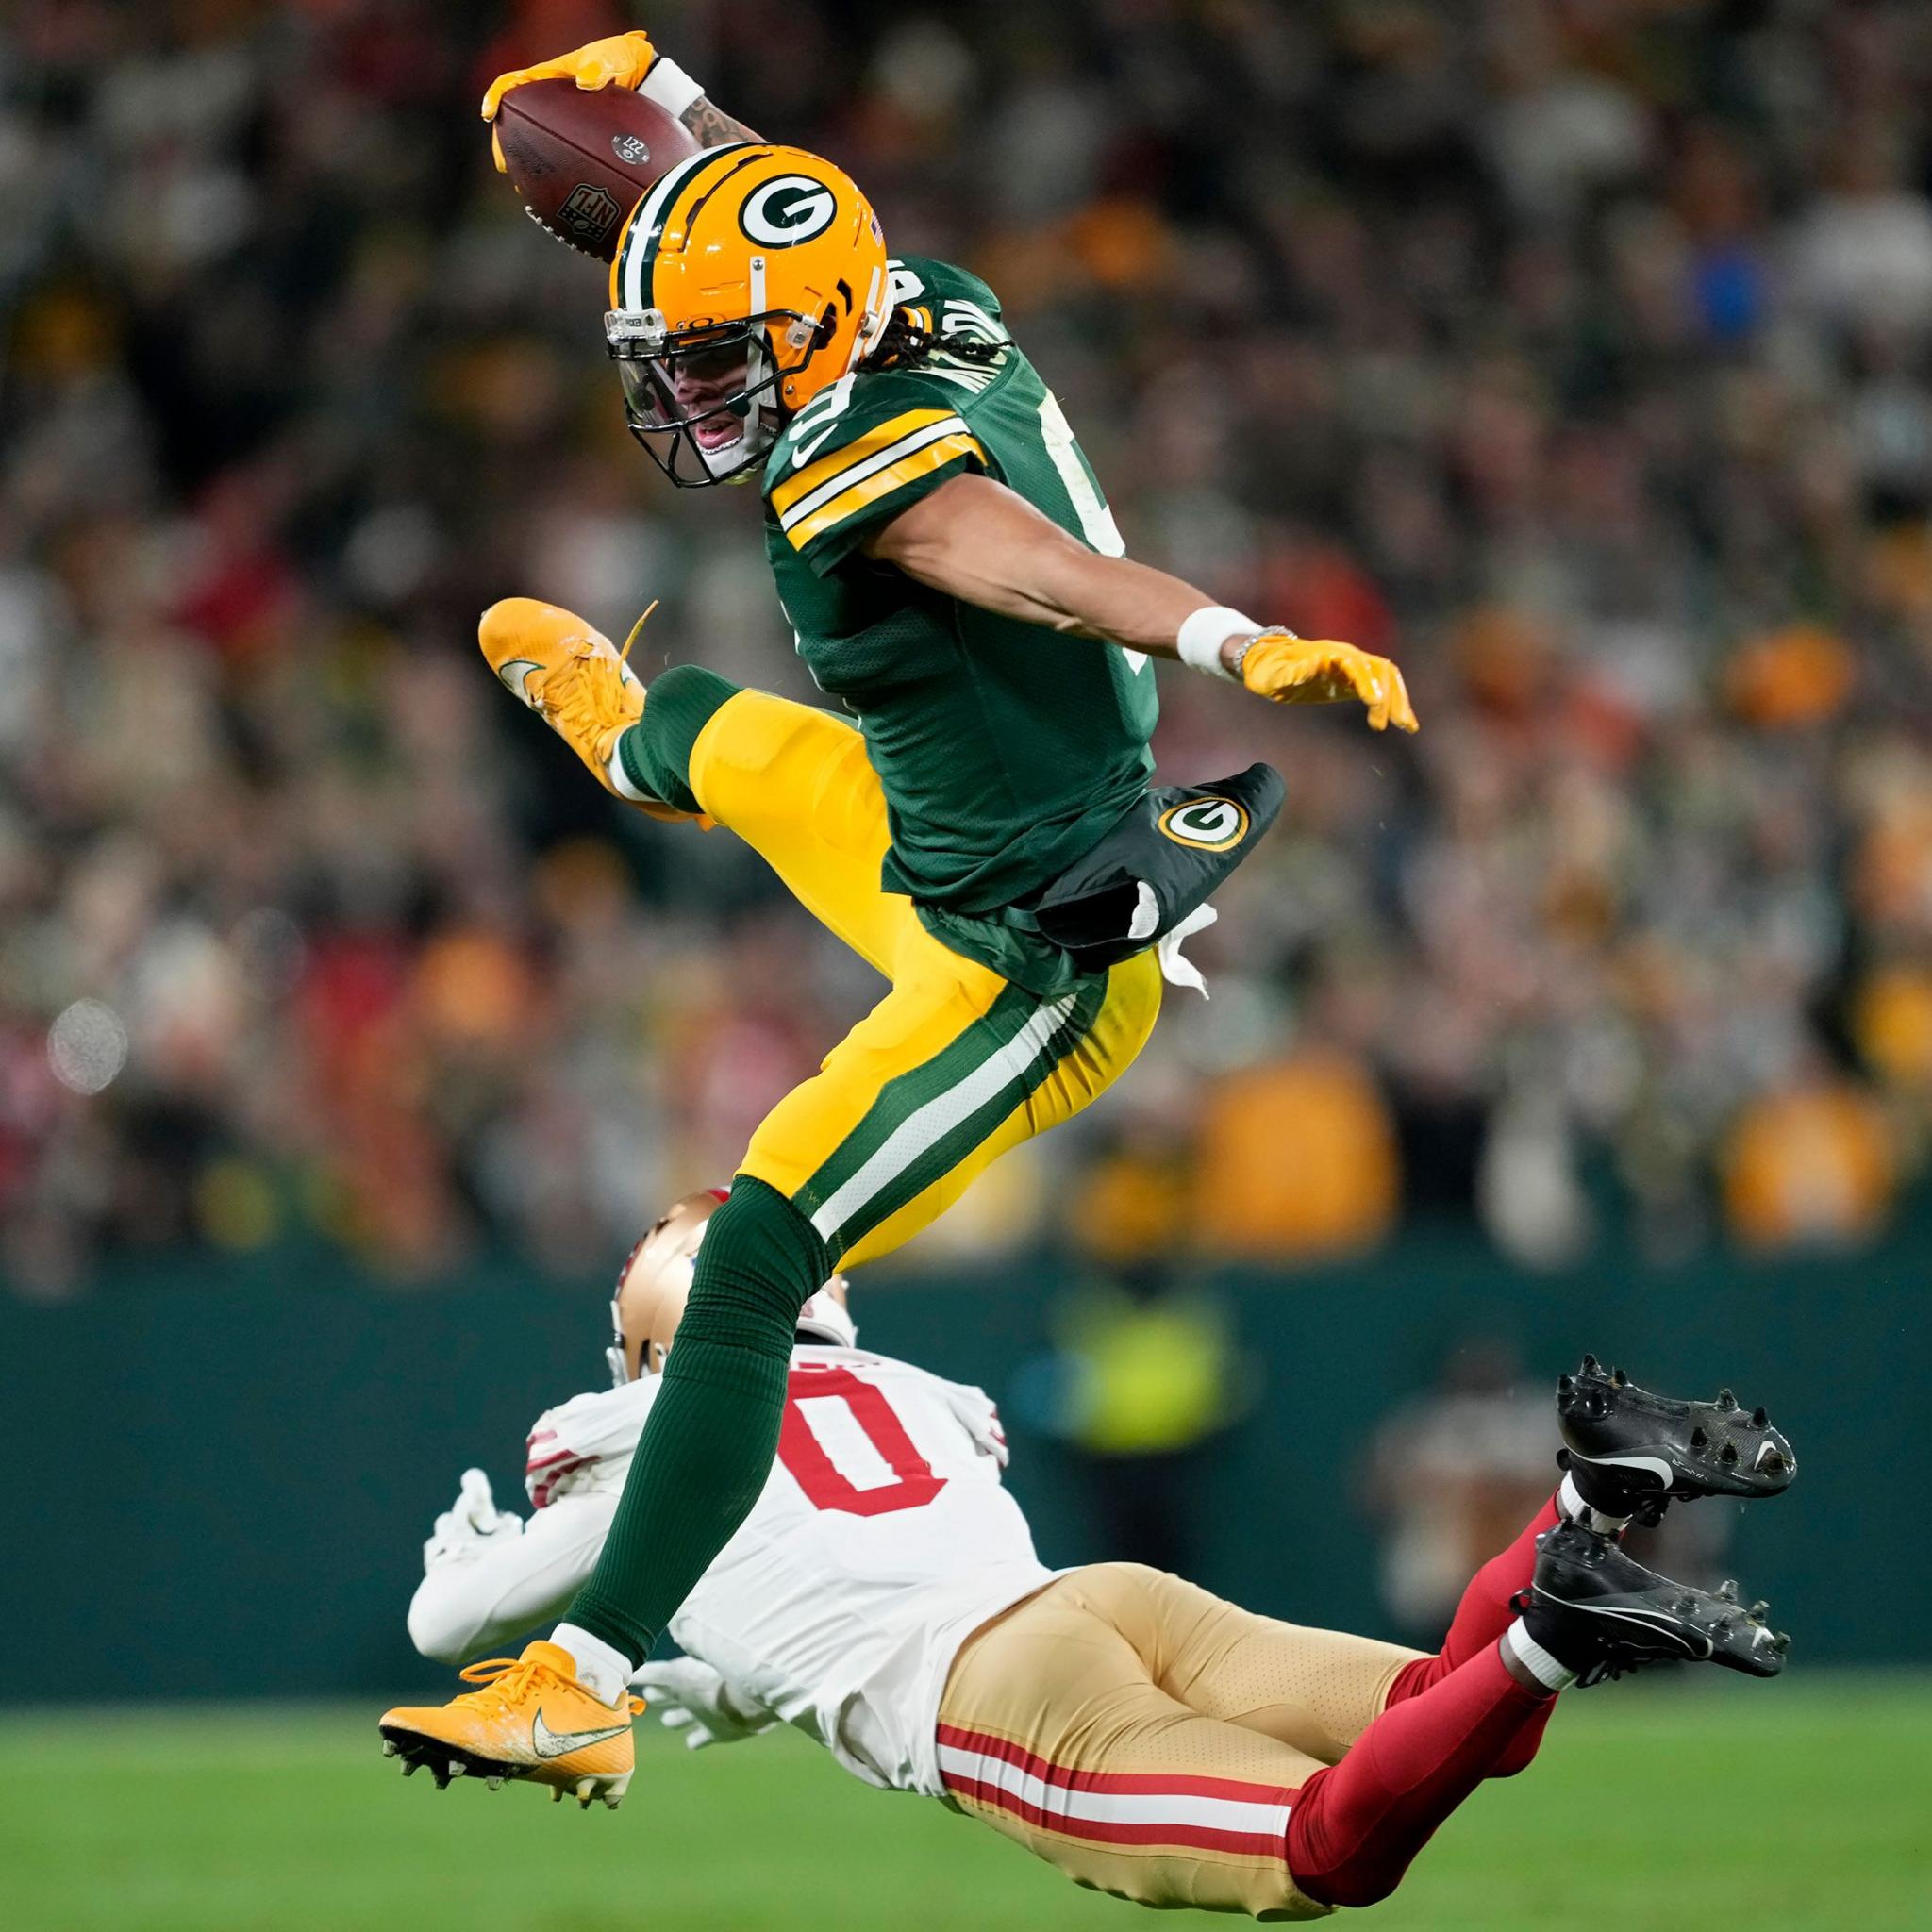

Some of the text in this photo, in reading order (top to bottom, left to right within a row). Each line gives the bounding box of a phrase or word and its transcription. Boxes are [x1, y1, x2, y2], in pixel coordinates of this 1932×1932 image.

[623, 136, 645, 156] 227
[574, 190, 615, 227] NFL
[741, 175, 836, 245] G
[1169, 800, 1240, 842] G
[777, 1370, 948, 1517] 0
